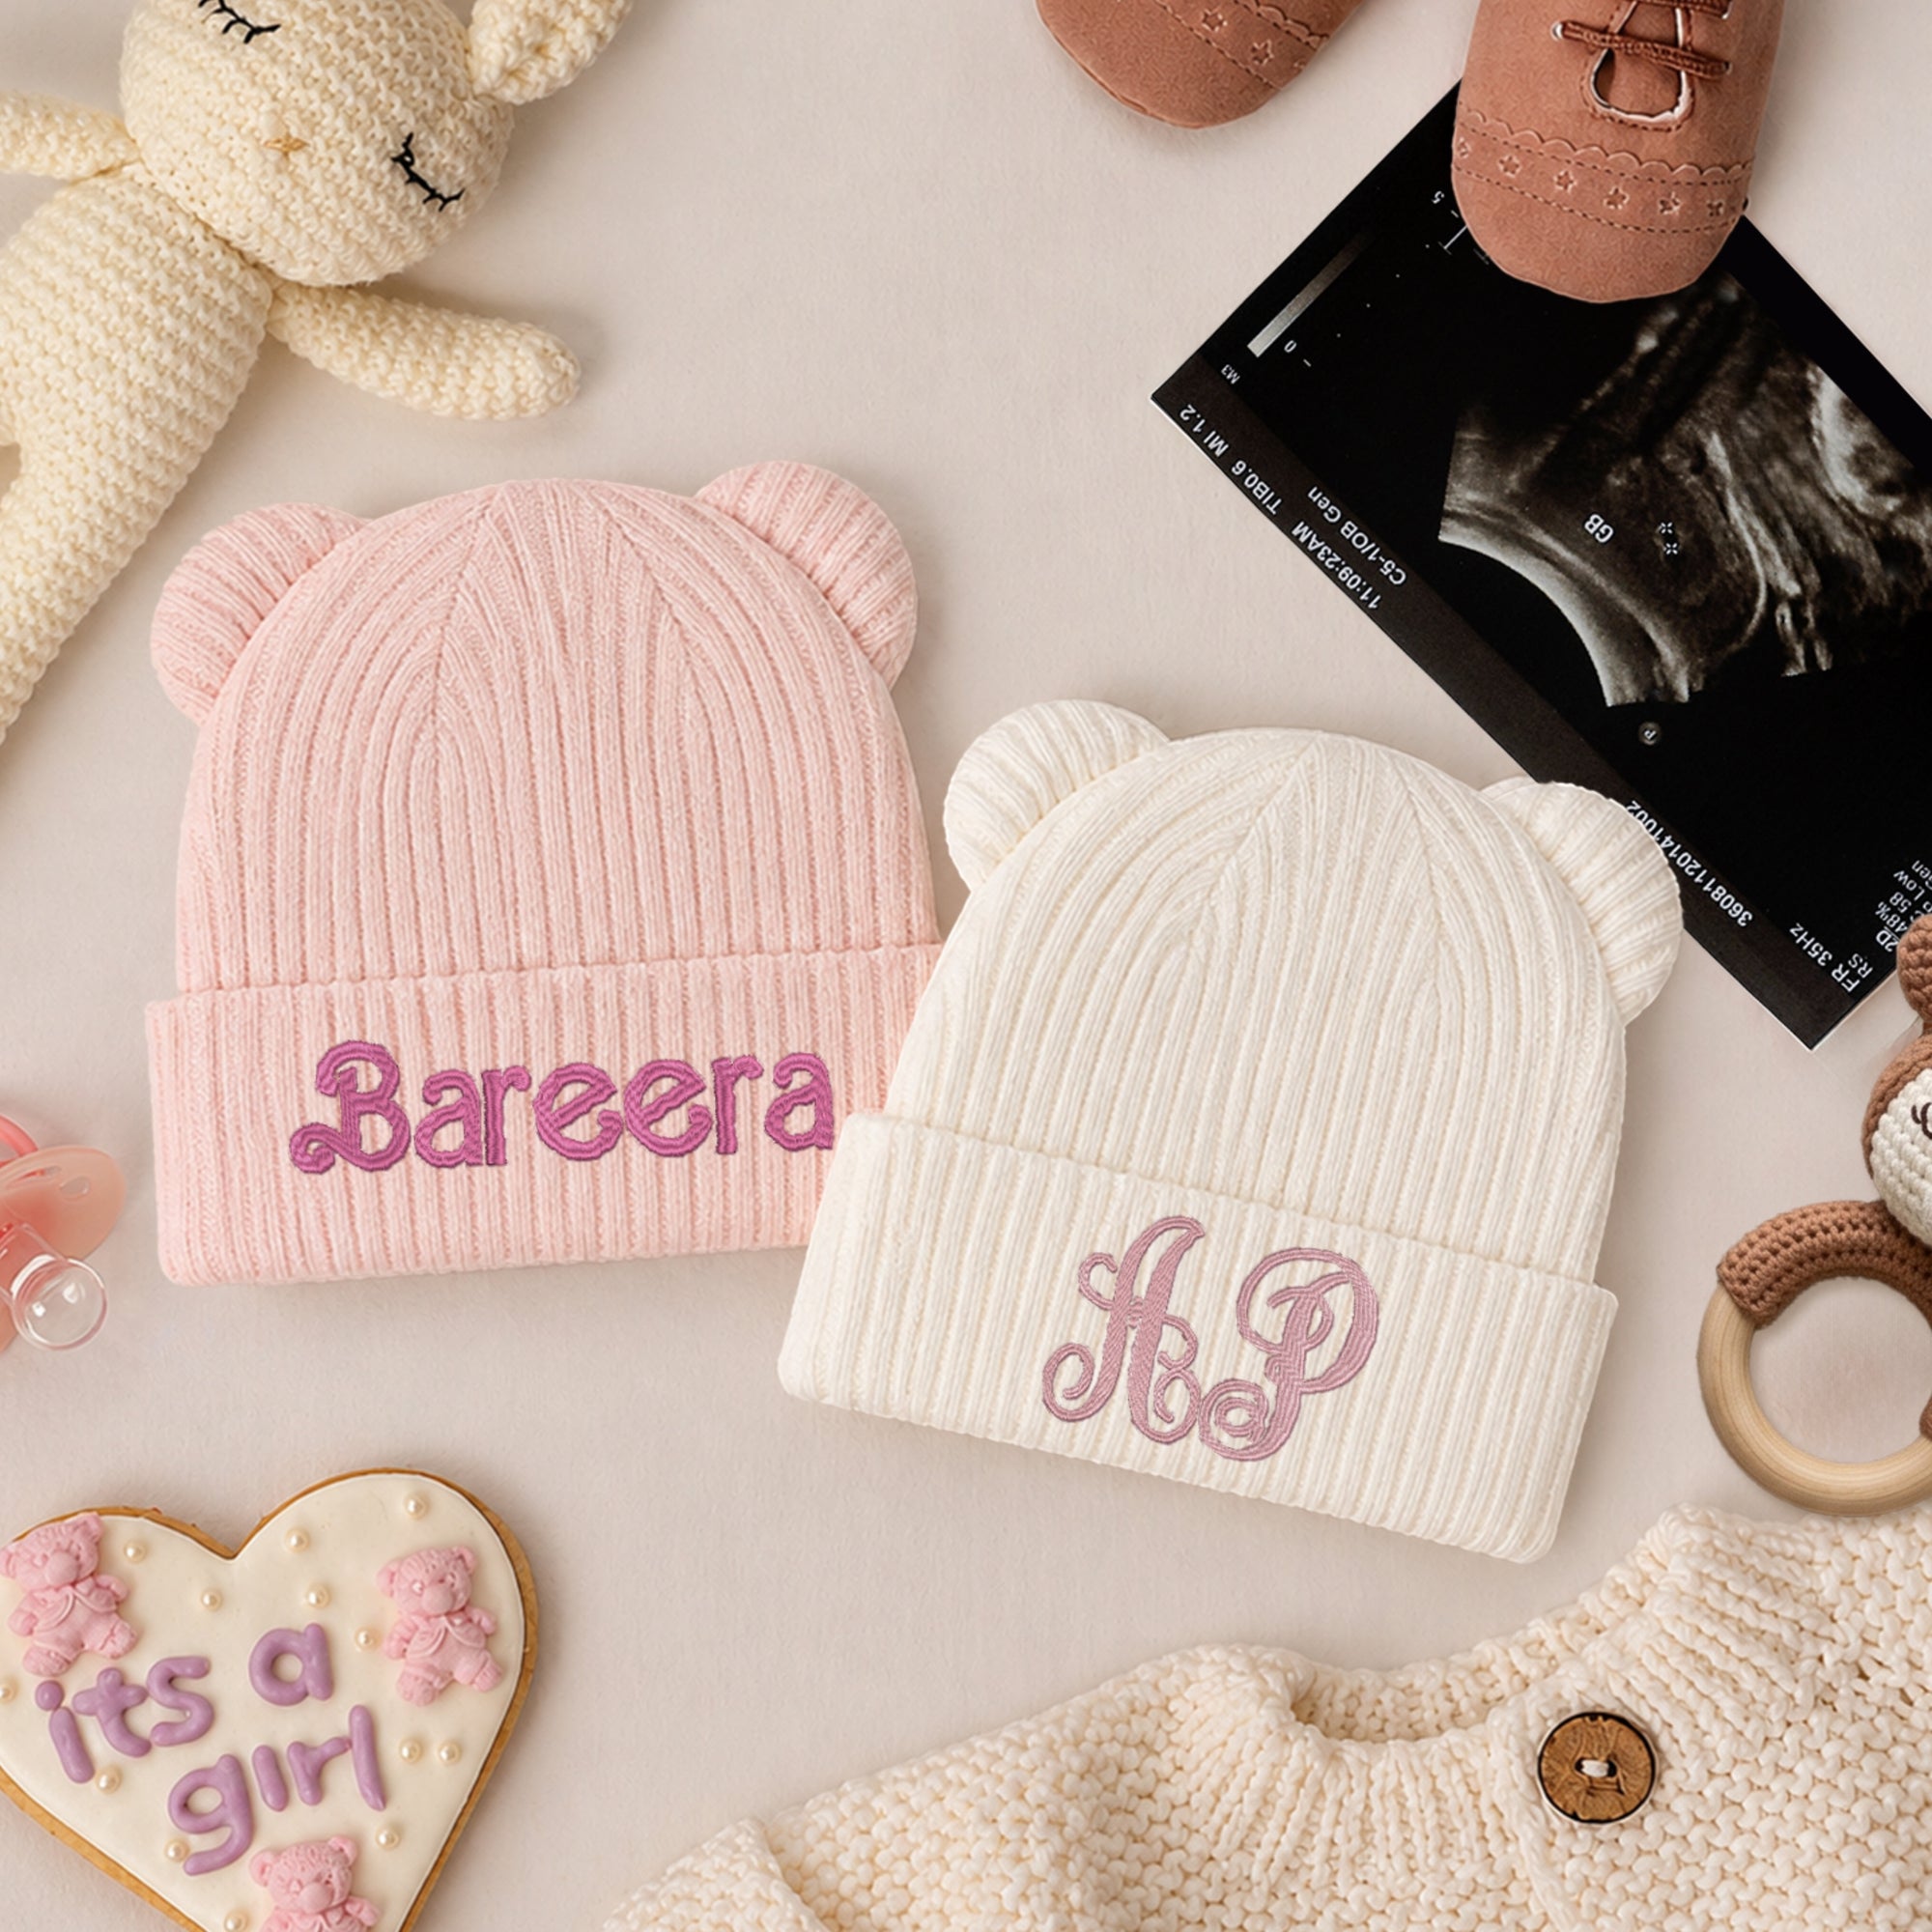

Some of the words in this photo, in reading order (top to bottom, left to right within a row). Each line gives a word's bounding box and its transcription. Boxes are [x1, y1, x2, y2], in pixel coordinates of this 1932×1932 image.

[1220, 363, 1241, 385] M3
[1179, 403, 1207, 435] 1.2
[1203, 429, 1230, 458] MI
[1231, 459, 1283, 516] TIB0.6
[1307, 486, 1342, 525] Gen
[1584, 514, 1614, 544] GB
[1292, 521, 1382, 611] 11:09:23AM
[1340, 522, 1407, 587] C5-1/OB
[1893, 870, 1925, 901] Low
[1889, 892, 1913, 914] 58
[1789, 923, 1833, 967] 35Hz
[1875, 927, 1900, 952] 2D
[1831, 963, 1861, 993] FR
[1847, 952, 1874, 979] RS
[289, 1038, 835, 1175] Bareera
[35, 1656, 214, 1784] its
[249, 1622, 333, 1707] a
[168, 1704, 386, 1876] girl
